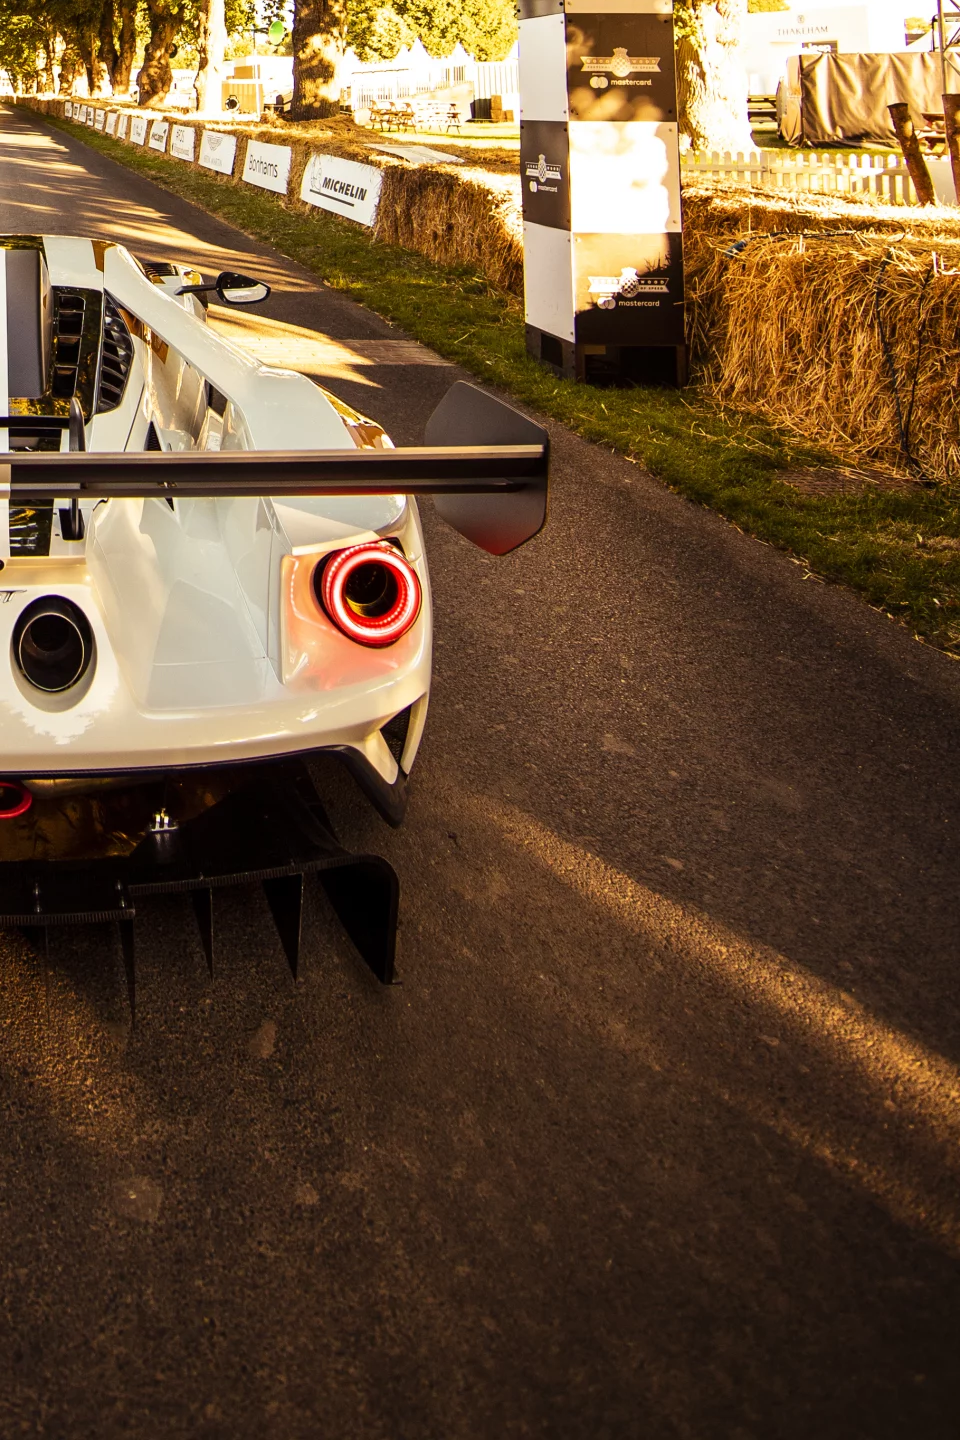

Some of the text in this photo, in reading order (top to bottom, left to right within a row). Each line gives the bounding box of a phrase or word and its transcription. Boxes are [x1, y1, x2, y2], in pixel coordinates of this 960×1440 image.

[777, 25, 829, 36] THAKEHAM
[610, 78, 652, 86] mastercard
[248, 154, 279, 178] Bonhams
[322, 176, 368, 201] MICHELIN
